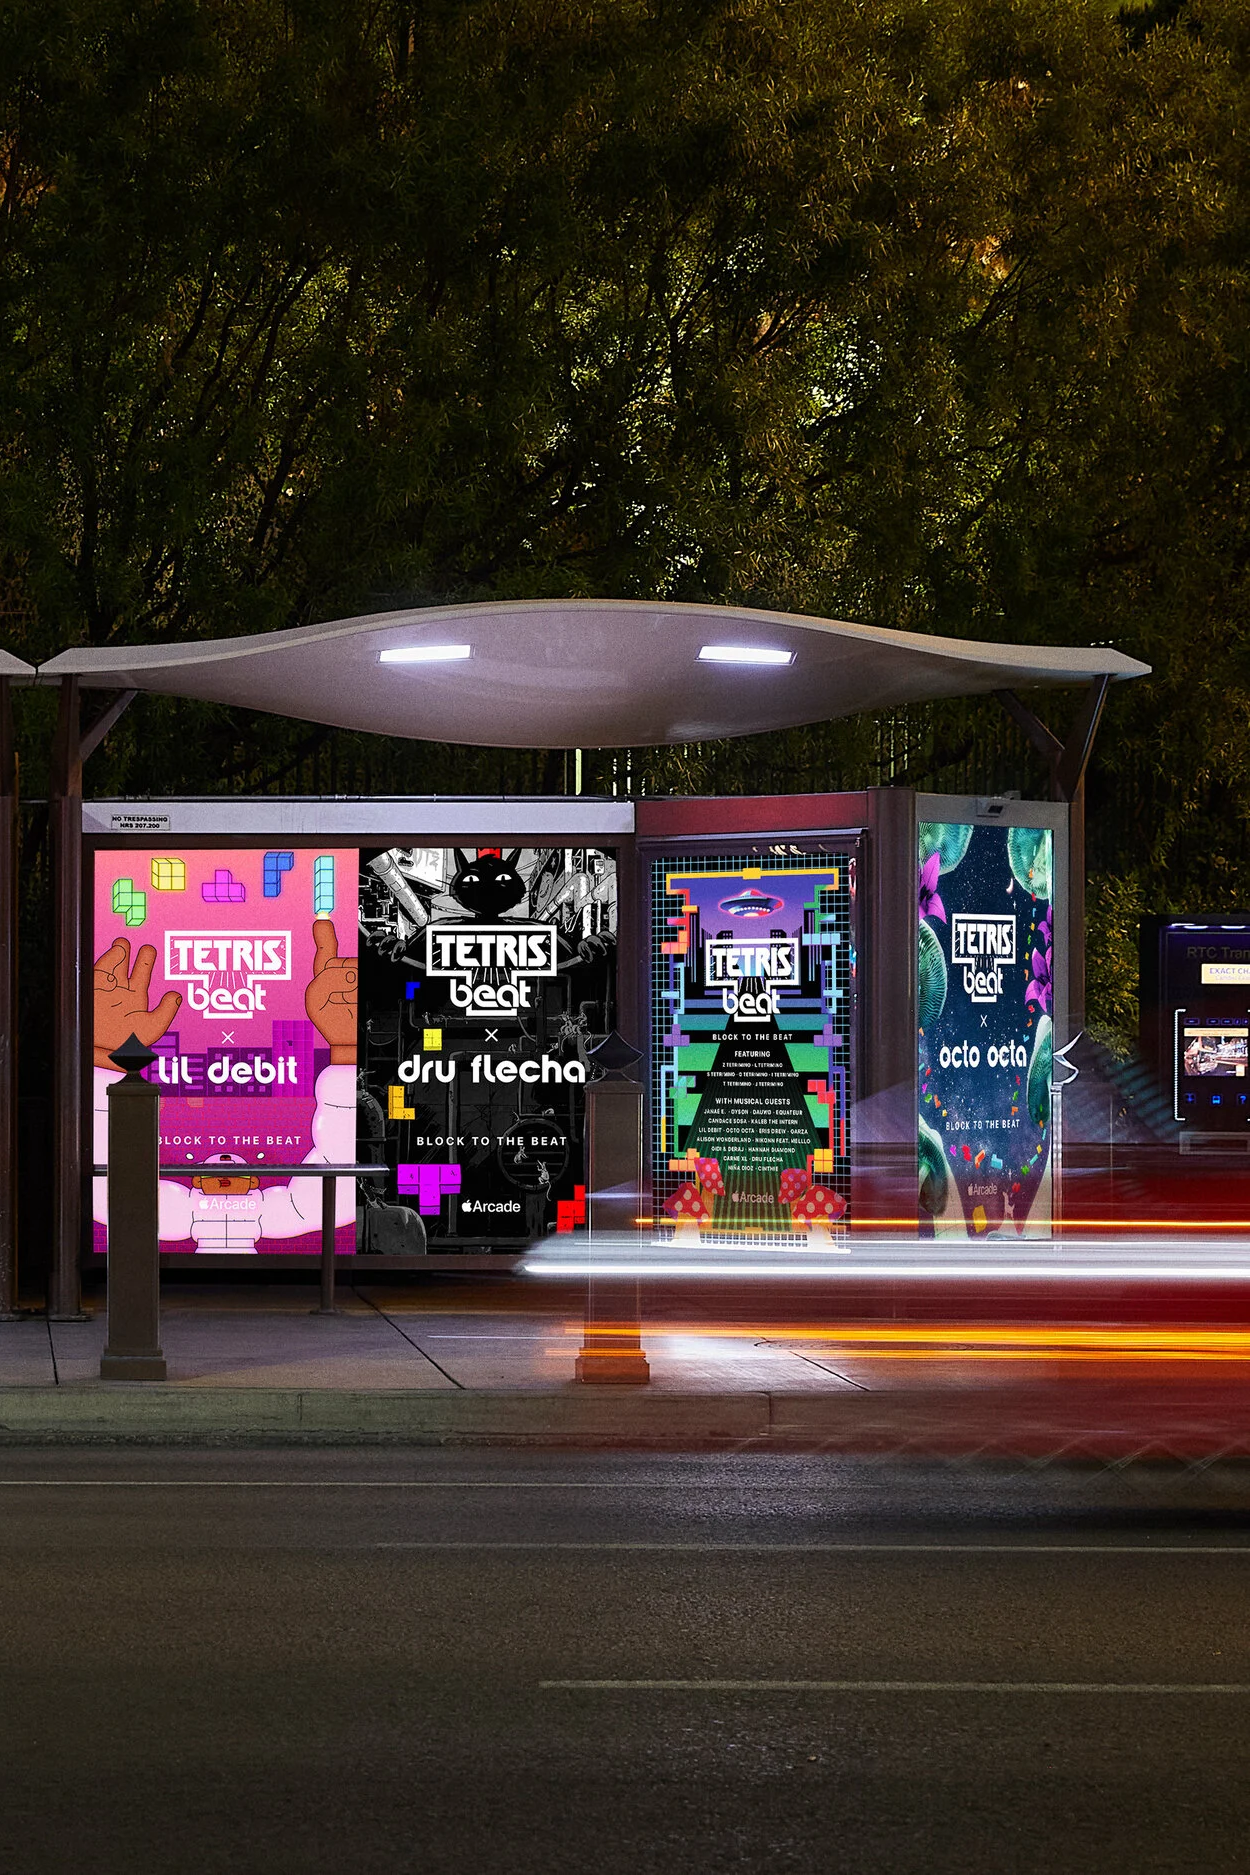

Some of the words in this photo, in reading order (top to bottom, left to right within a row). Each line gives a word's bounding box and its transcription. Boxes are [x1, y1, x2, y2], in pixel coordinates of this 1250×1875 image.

[436, 935, 547, 966] TETRIS
[957, 923, 1011, 954] TETRIS
[174, 940, 282, 971] TETRIS
[712, 947, 792, 977] TETRIS
[1187, 946, 1217, 959] RTC
[450, 979, 531, 1007] beat
[964, 966, 1003, 994] beat
[188, 983, 266, 1010] beat
[723, 988, 780, 1014] beat
[940, 1040, 980, 1068] octo
[987, 1040, 1027, 1068] octa
[158, 1056, 192, 1084] lil
[207, 1056, 297, 1084] debit
[398, 1054, 456, 1083] dru
[471, 1054, 585, 1083] flecha
[946, 1121, 970, 1131] BLOCK
[973, 1120, 982, 1129] TO
[986, 1120, 999, 1128] THE
[1002, 1119, 1020, 1128] BEAT
[158, 1136, 202, 1145] BLOCK
[209, 1136, 226, 1145] TO
[233, 1136, 259, 1145] THE
[266, 1136, 301, 1145] BEAT
[417, 1137, 464, 1146] BLOCK
[472, 1137, 489, 1146] TO
[497, 1137, 524, 1146] THE
[531, 1137, 567, 1146] BEAT
[740, 1191, 774, 1203] Arcade
[973, 1183, 997, 1196] Arcade
[210, 1198, 256, 1210] Arcade
[472, 1200, 521, 1212] Arcade
